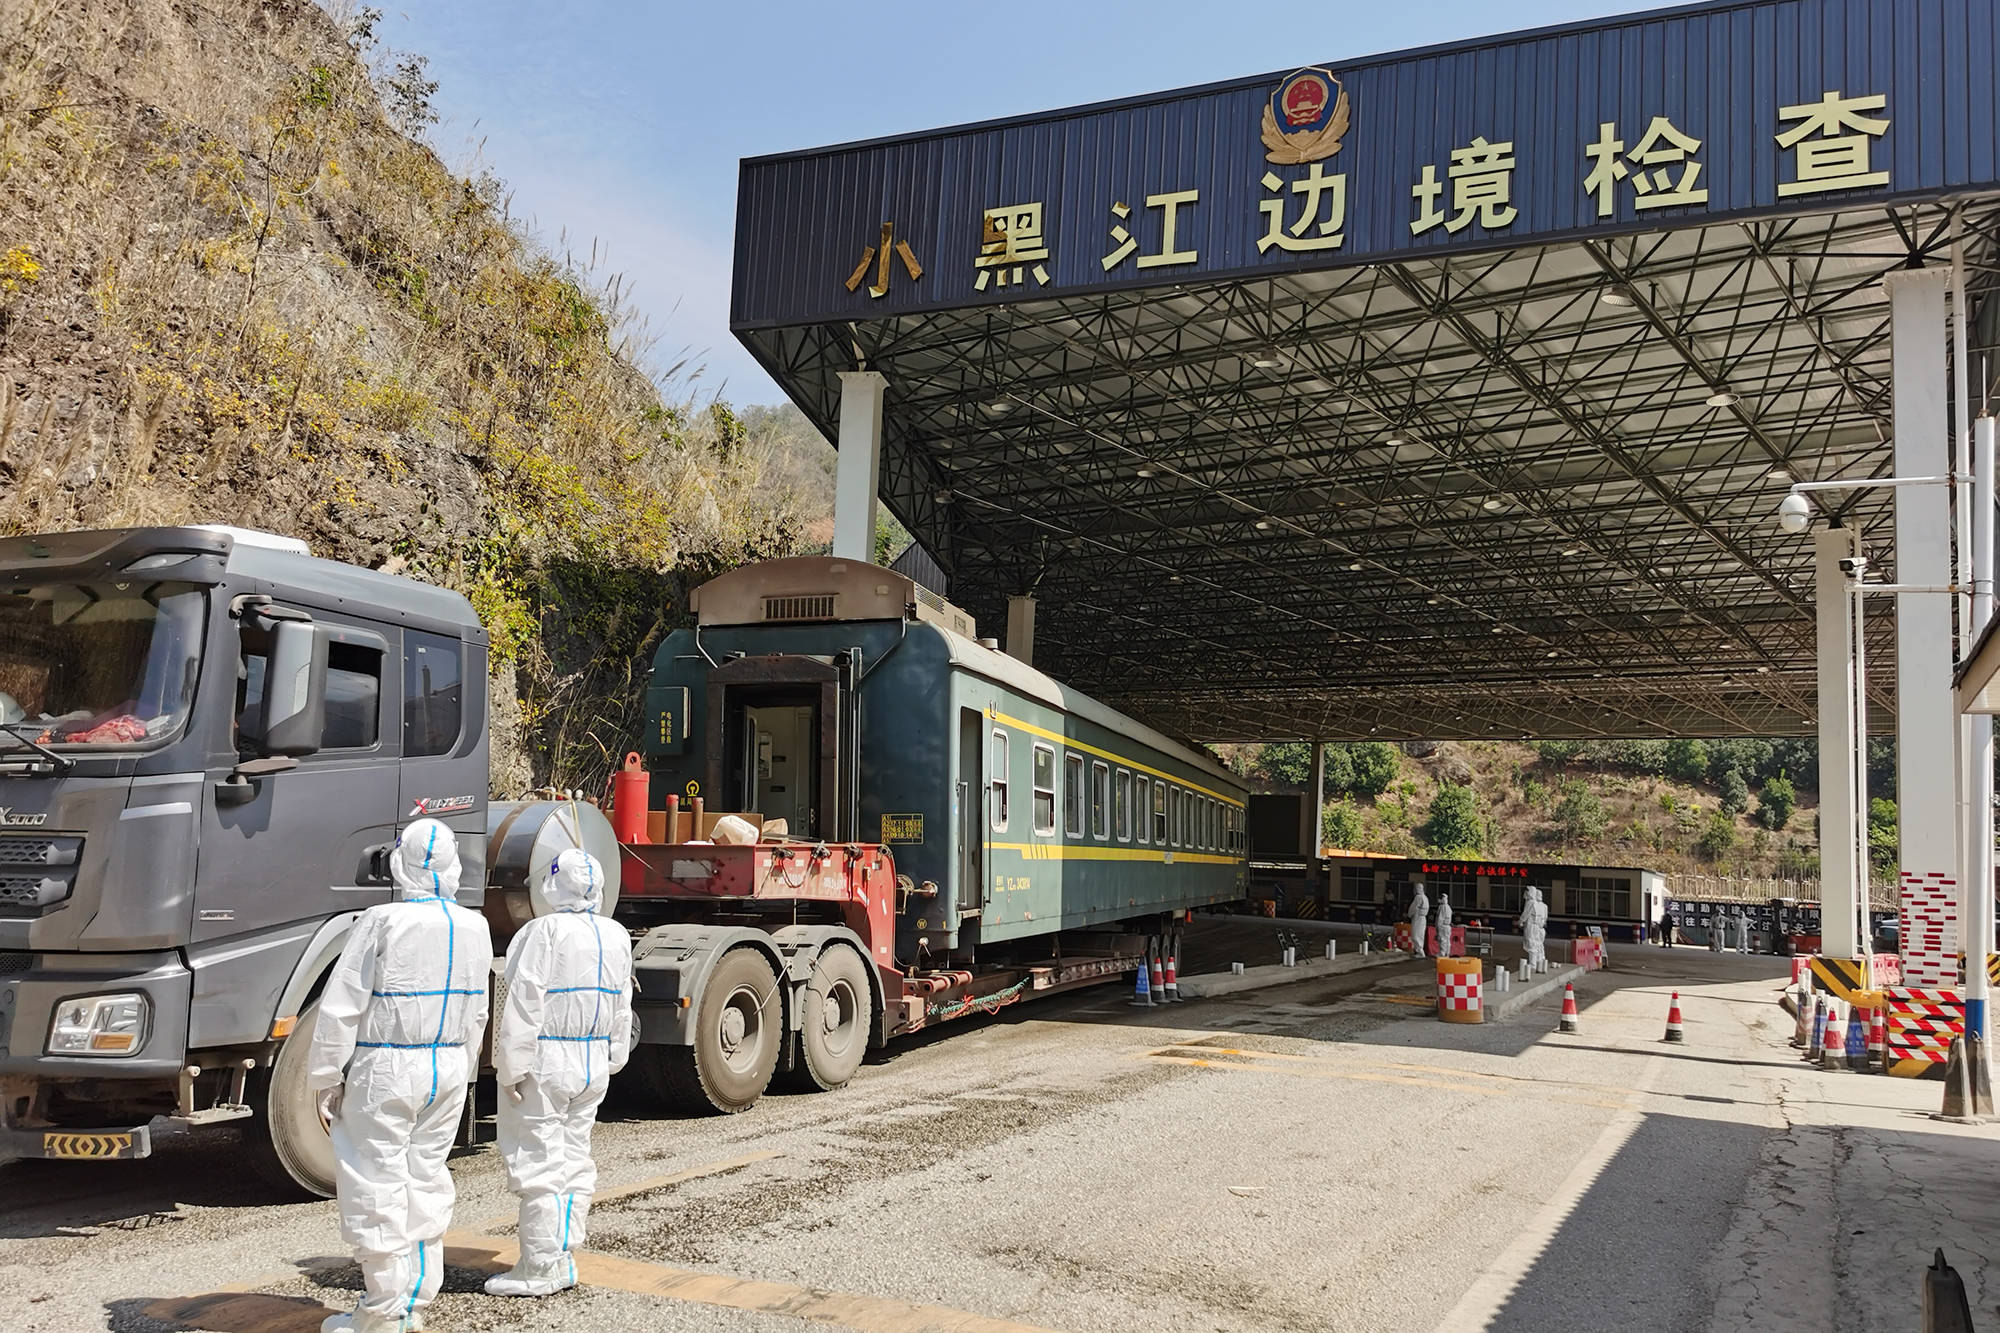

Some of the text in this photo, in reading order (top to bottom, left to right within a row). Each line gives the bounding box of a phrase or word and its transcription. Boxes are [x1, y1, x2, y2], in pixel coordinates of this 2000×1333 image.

[845, 90, 1890, 299] 小黑江边境检查
[0, 807, 48, 825] X3000
